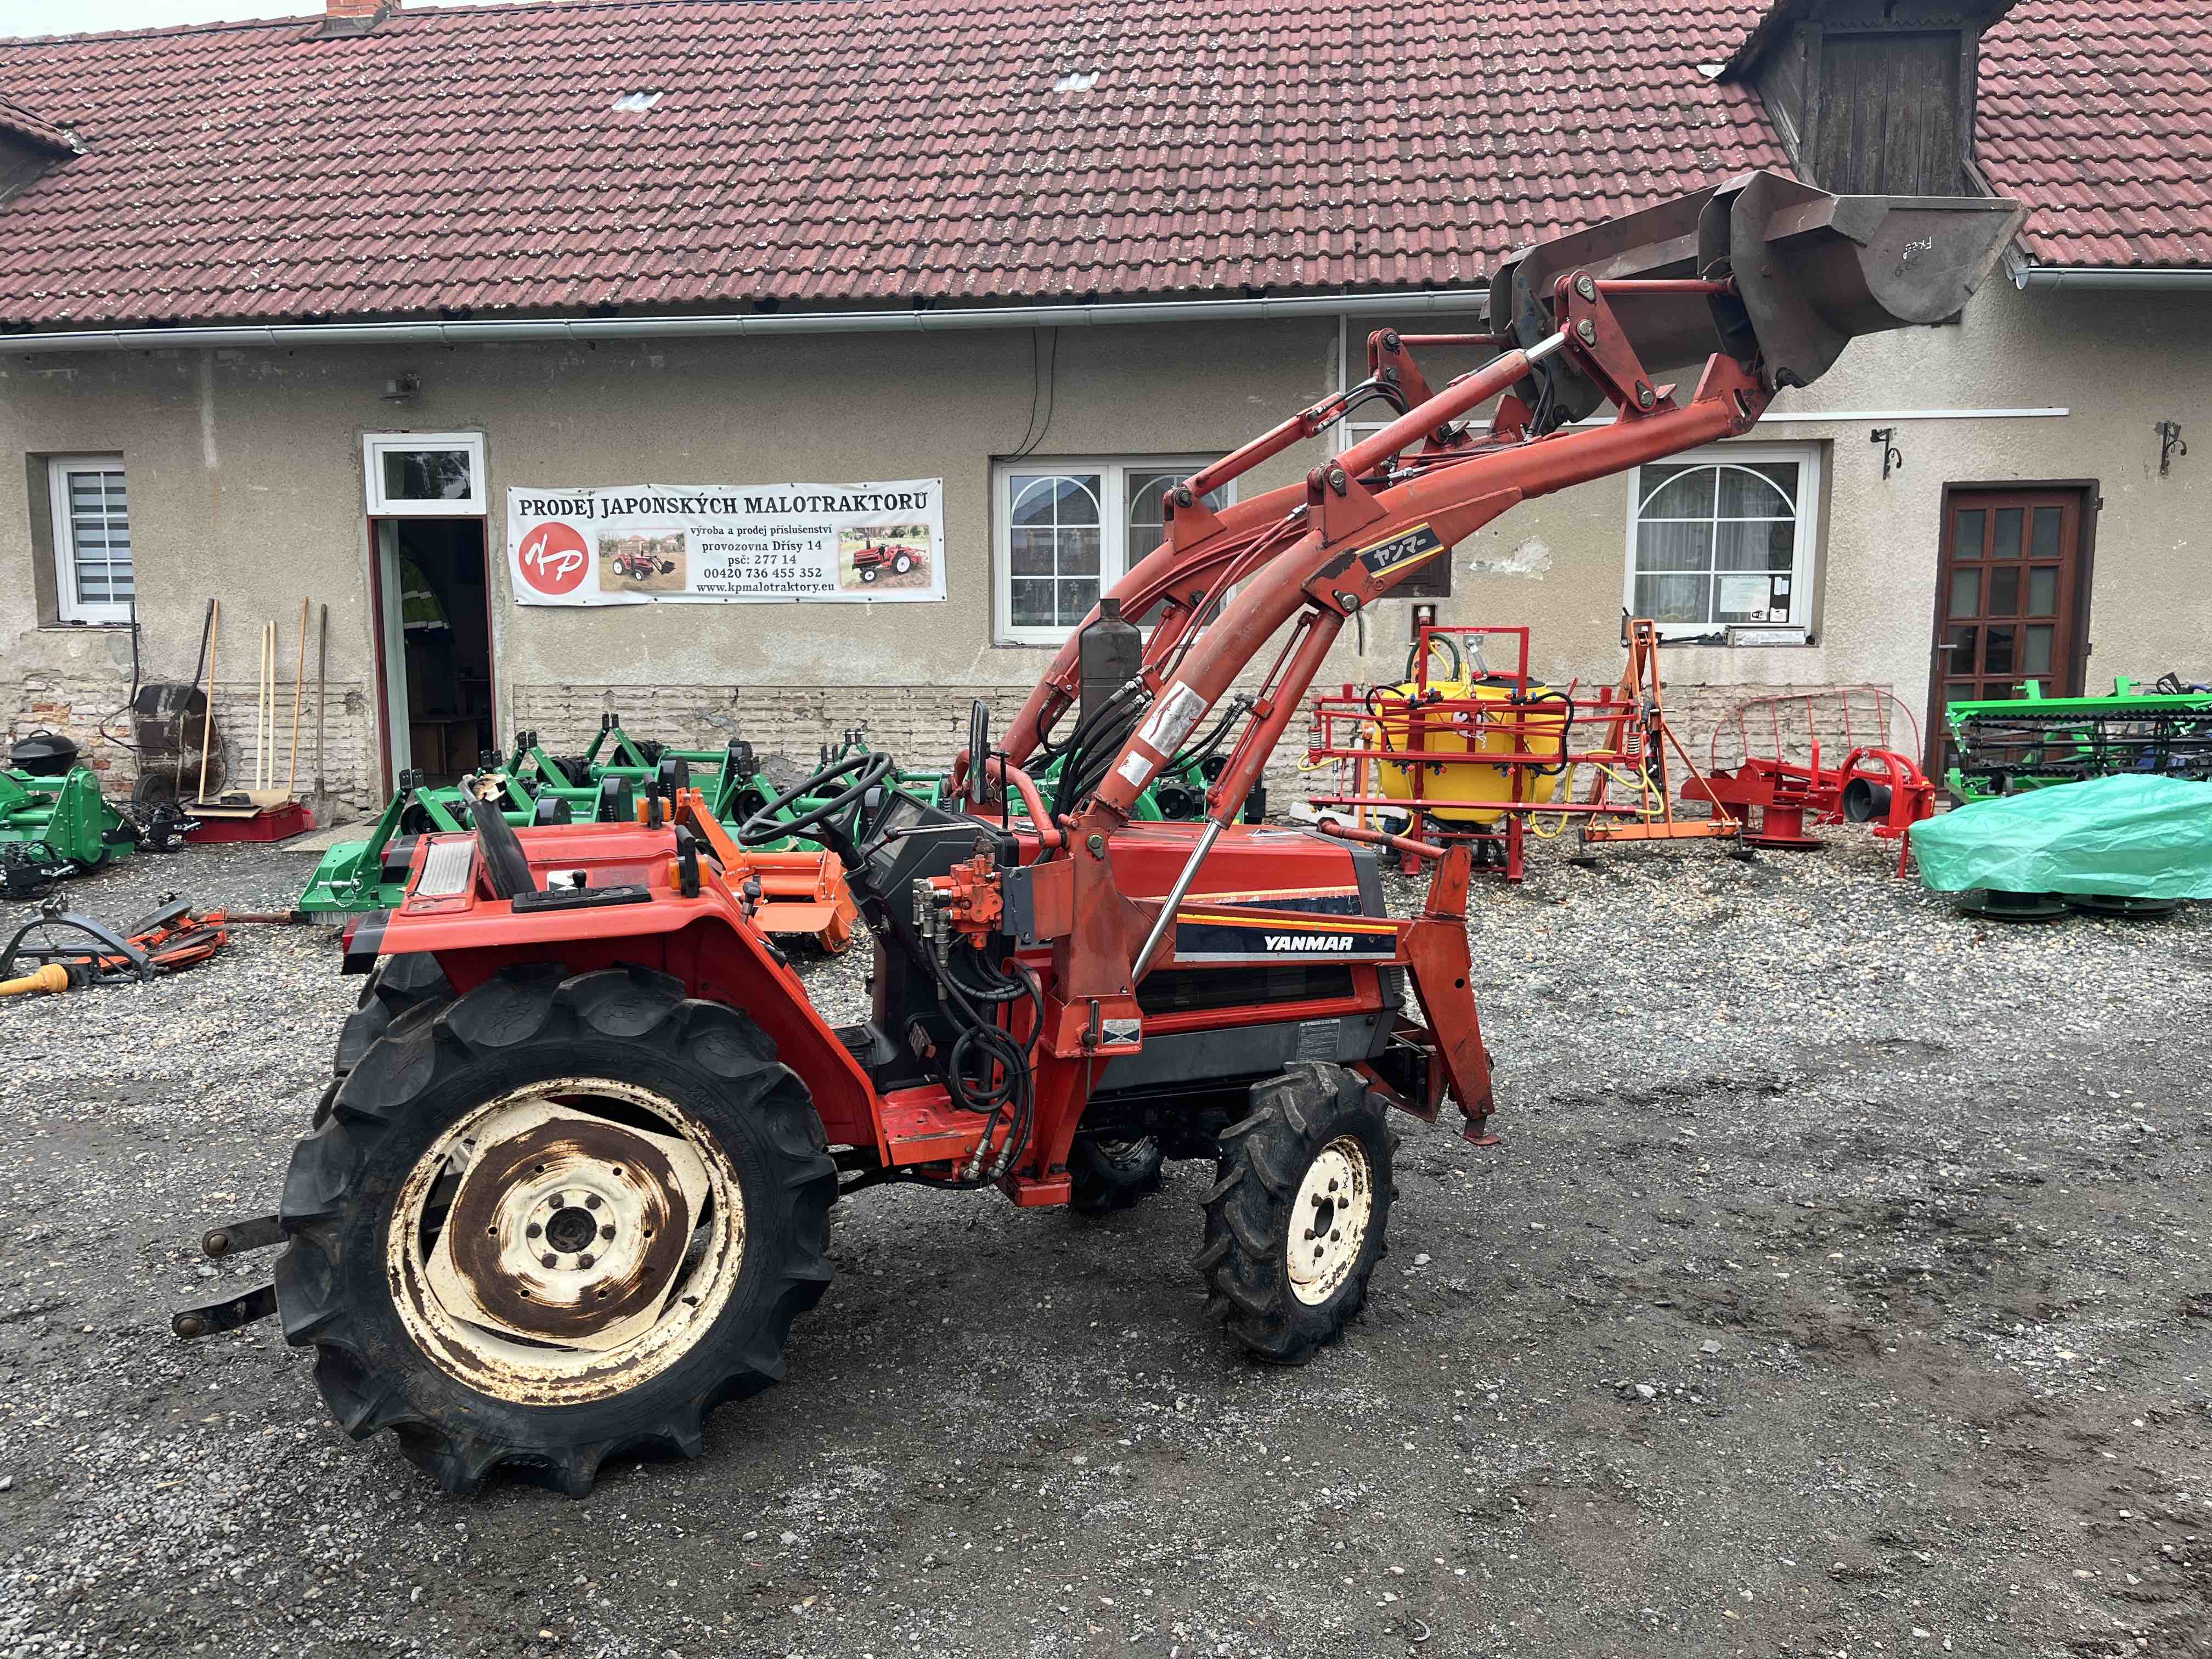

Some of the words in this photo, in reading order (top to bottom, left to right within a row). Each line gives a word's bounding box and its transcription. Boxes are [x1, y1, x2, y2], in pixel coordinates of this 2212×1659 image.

[520, 499, 596, 519] PRODEJ
[601, 492, 738, 519] JAPONSKÝCH
[744, 492, 928, 514] MALOTRAKTORŮ
[690, 526, 724, 536] výroba
[737, 525, 766, 537] prodej
[771, 524, 833, 536] příslušenství
[702, 543, 768, 553] provozovna
[772, 540, 803, 553] Dřísy
[807, 540, 822, 550] 14
[1373, 536, 1426, 567] ヤンマー
[727, 555, 750, 567] psč:
[754, 555, 778, 565] 277
[782, 555, 797, 565] 14
[704, 568, 741, 578] 00420
[746, 568, 768, 578] 736
[772, 568, 795, 578] 455
[799, 568, 822, 578] 352
[697, 582, 834, 594] www.kpmalotraktory.eu
[1265, 936, 1353, 951] YANMAR
